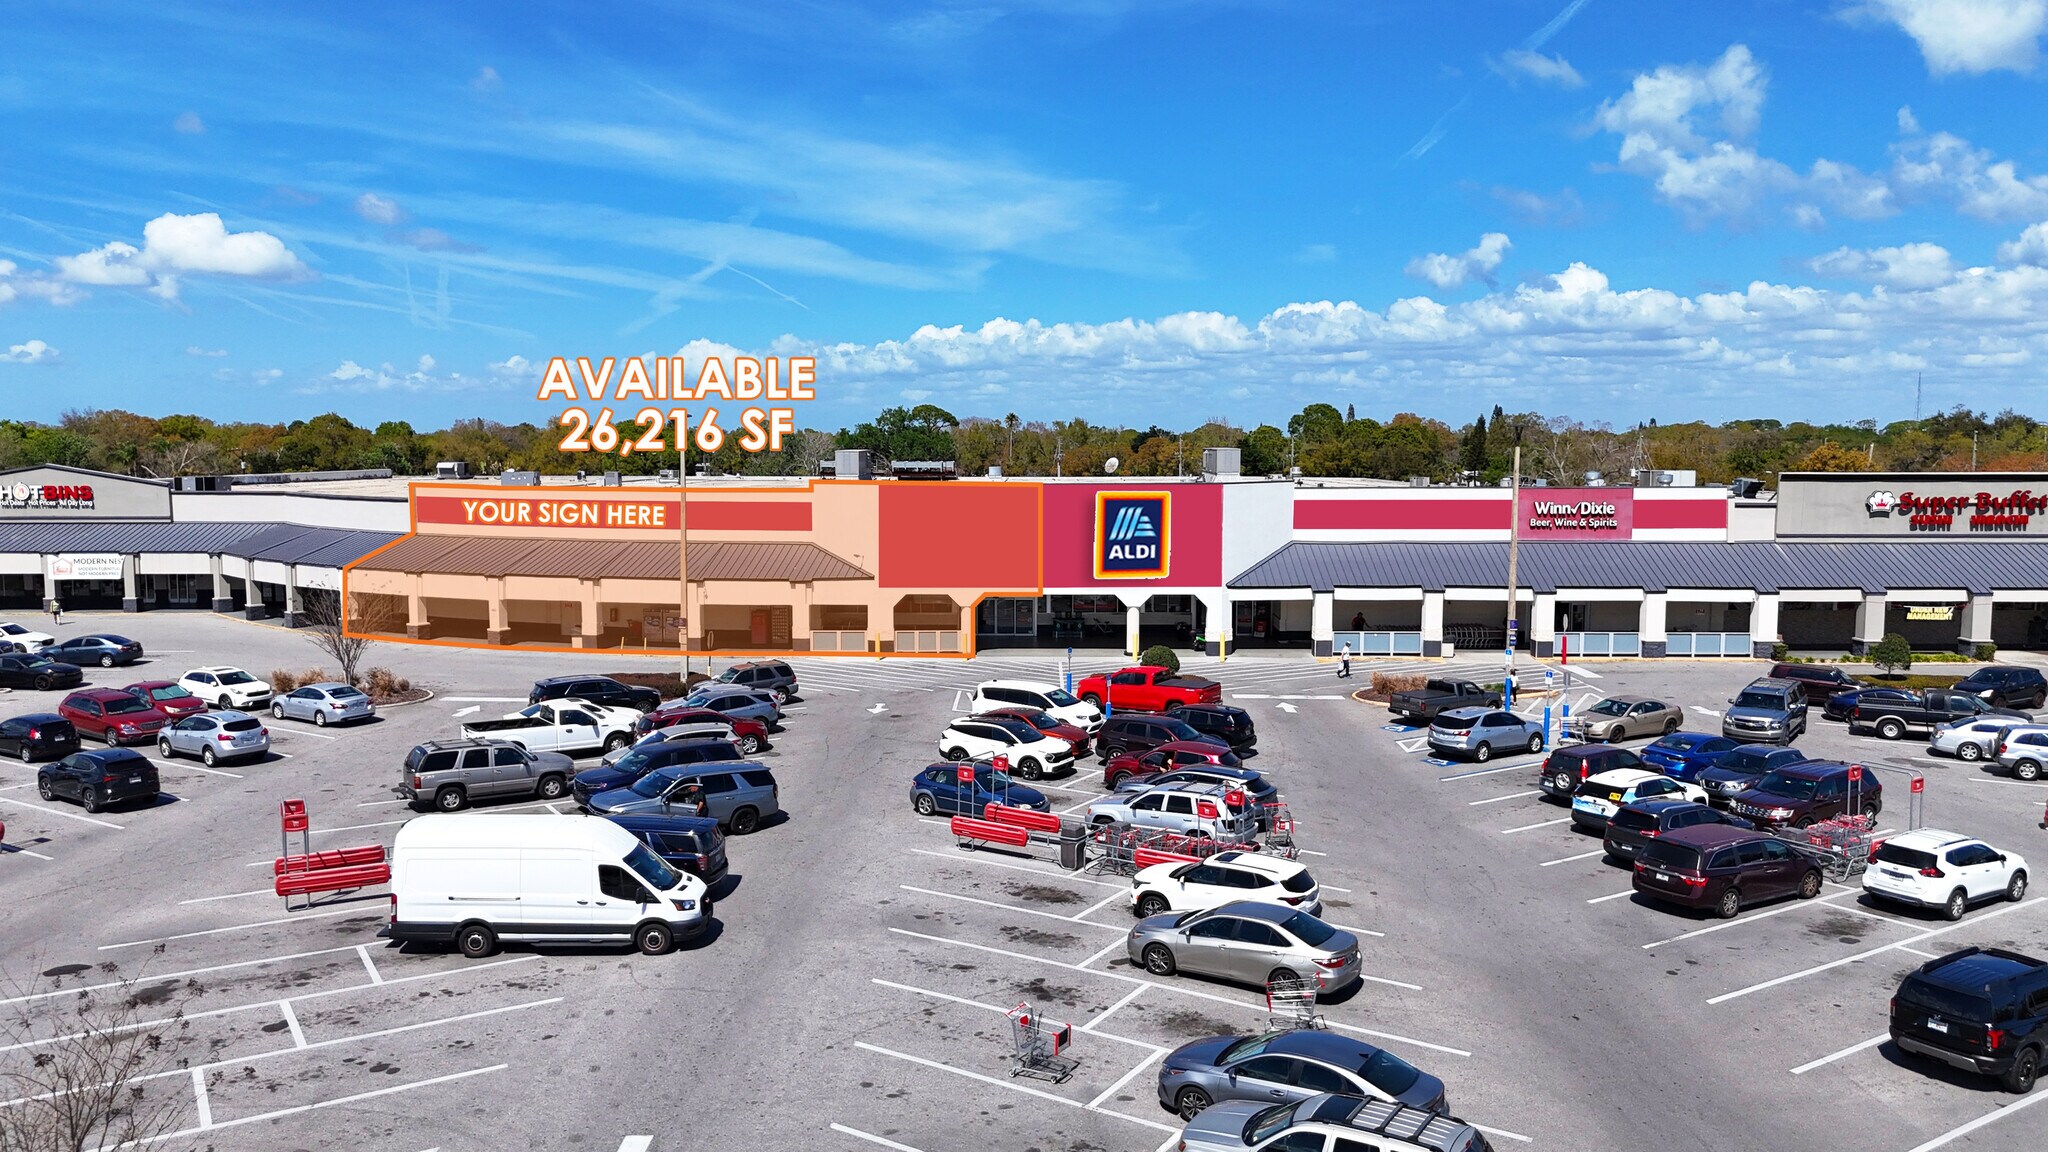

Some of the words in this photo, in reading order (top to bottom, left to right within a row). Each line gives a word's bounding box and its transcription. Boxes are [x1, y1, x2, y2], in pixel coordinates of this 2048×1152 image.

[43, 485, 94, 500] BINS
[1898, 491, 1970, 514] Super
[1974, 489, 2048, 512] Buffet
[1529, 518, 1553, 528] Beer,
[1554, 518, 1578, 527] Wine
[1579, 518, 1587, 527] &
[1588, 518, 1618, 528] Spirits
[1909, 514, 1953, 526] SUSHI
[1969, 514, 2029, 526] HIBACHI
[1108, 544, 1156, 560] ALDI
